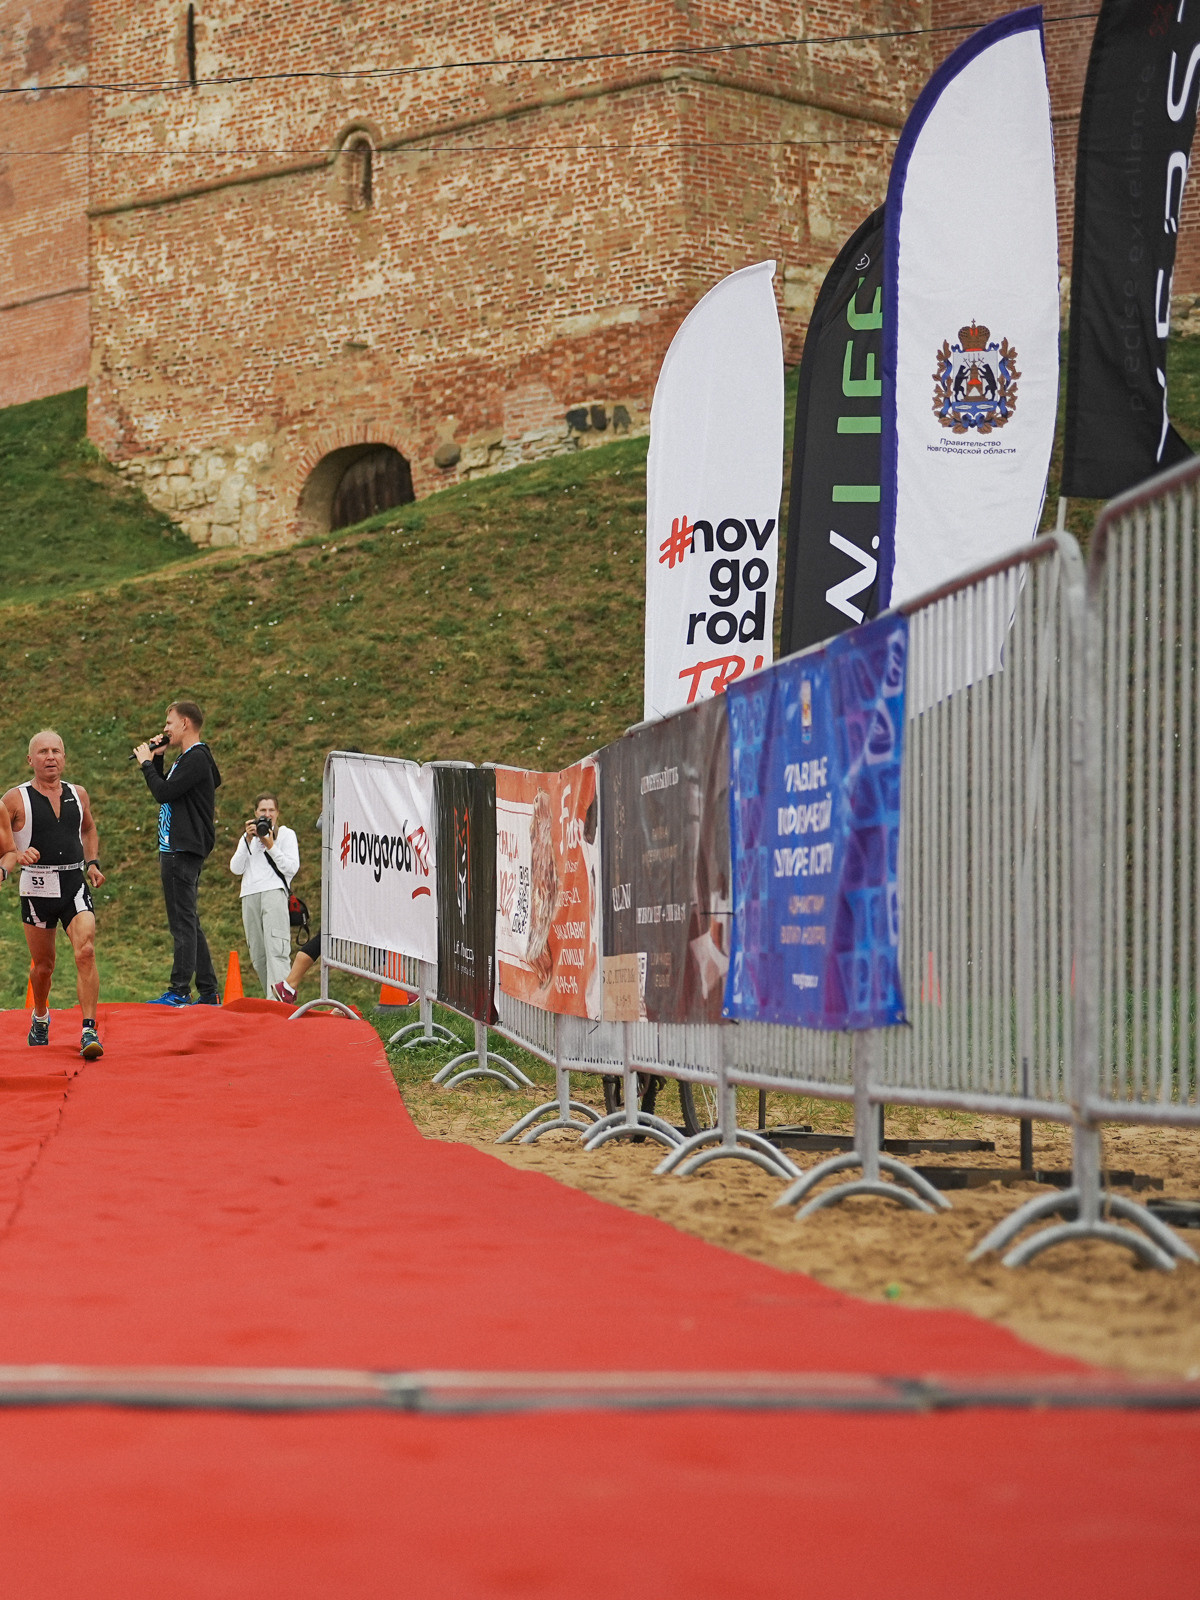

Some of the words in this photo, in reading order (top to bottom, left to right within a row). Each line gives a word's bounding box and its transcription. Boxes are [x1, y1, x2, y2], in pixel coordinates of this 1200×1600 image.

[927, 445, 981, 455] Новгородской
[983, 447, 1016, 455] области
[940, 438, 1001, 447] Правительство
[659, 515, 776, 569] #nov
[709, 558, 769, 607] go
[687, 592, 766, 645] rod
[31, 876, 45, 886] 53
